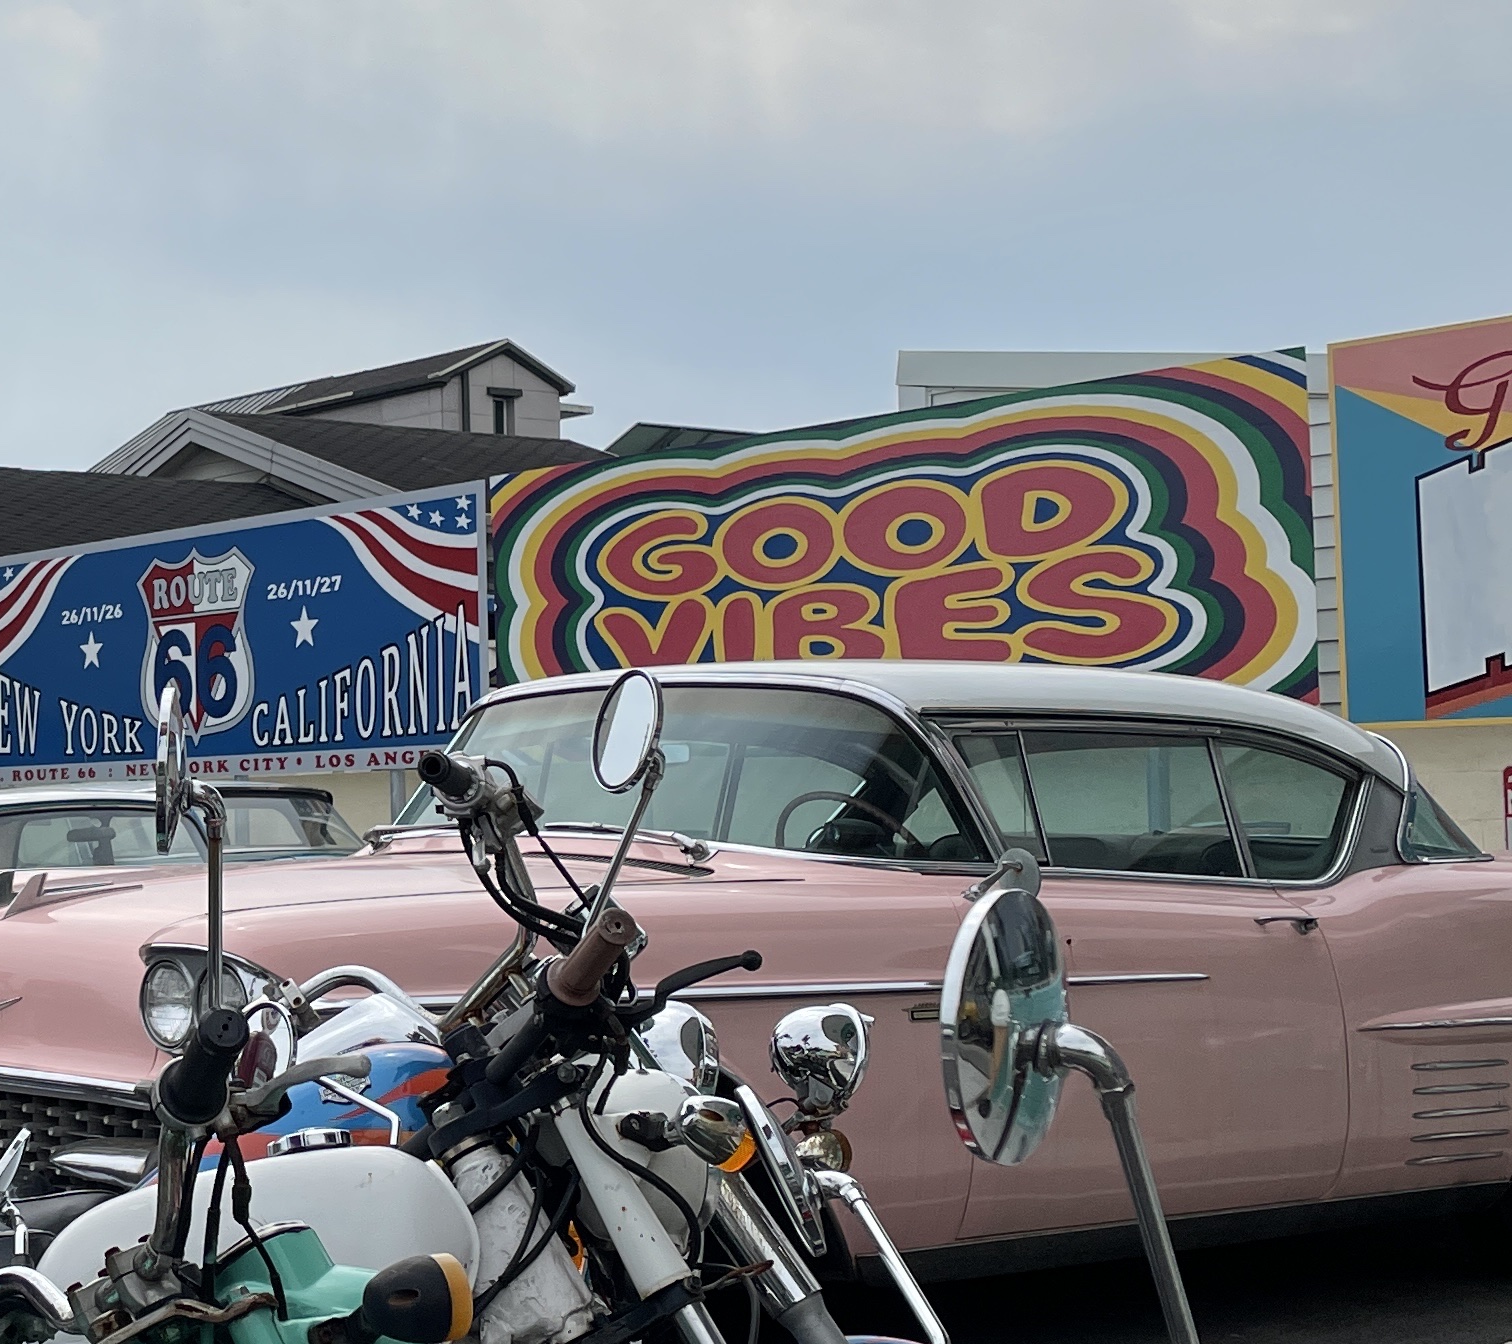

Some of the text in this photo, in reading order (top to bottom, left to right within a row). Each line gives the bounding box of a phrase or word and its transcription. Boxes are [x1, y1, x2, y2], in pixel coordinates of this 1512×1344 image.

[596, 460, 1130, 601] GOOD
[61, 604, 123, 626] 26/11/26
[152, 568, 238, 610] ROUTE
[266, 575, 342, 601] 26/11/27
[594, 544, 1179, 665] VIBES
[153, 624, 238, 719] 66
[252, 602, 473, 747] CALIFORNIA
[58, 698, 145, 755] YORK
[12, 768, 70, 782] ROUTE
[77, 767, 97, 779] 66
[189, 760, 230, 774] ORK
[239, 757, 290, 772] CITY
[315, 755, 356, 769] LOS
